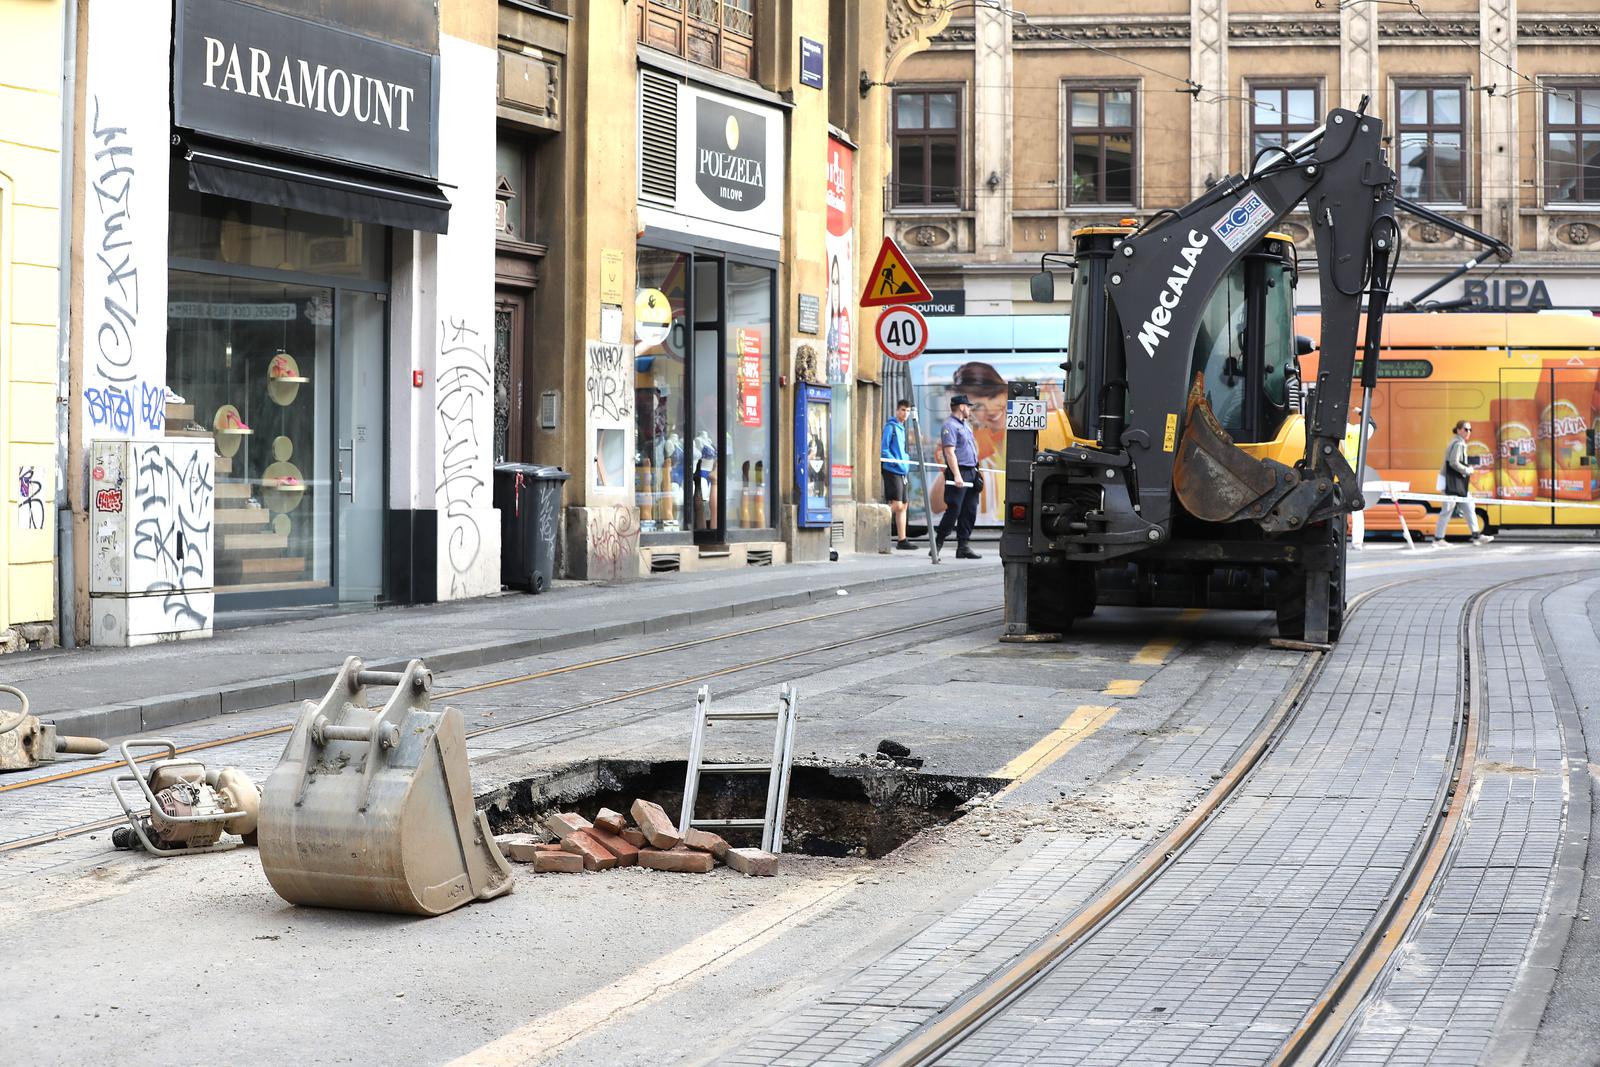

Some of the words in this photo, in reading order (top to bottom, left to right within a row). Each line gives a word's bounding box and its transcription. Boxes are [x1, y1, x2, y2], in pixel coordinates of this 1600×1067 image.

[202, 36, 414, 132] PARAMOUNT
[699, 148, 764, 188] POLZELA
[1217, 197, 1260, 237] LAGER
[1463, 280, 1553, 308] BIPA
[914, 304, 956, 313] BOUTIQUE
[887, 319, 917, 347] 40
[1019, 402, 1034, 415] ZG
